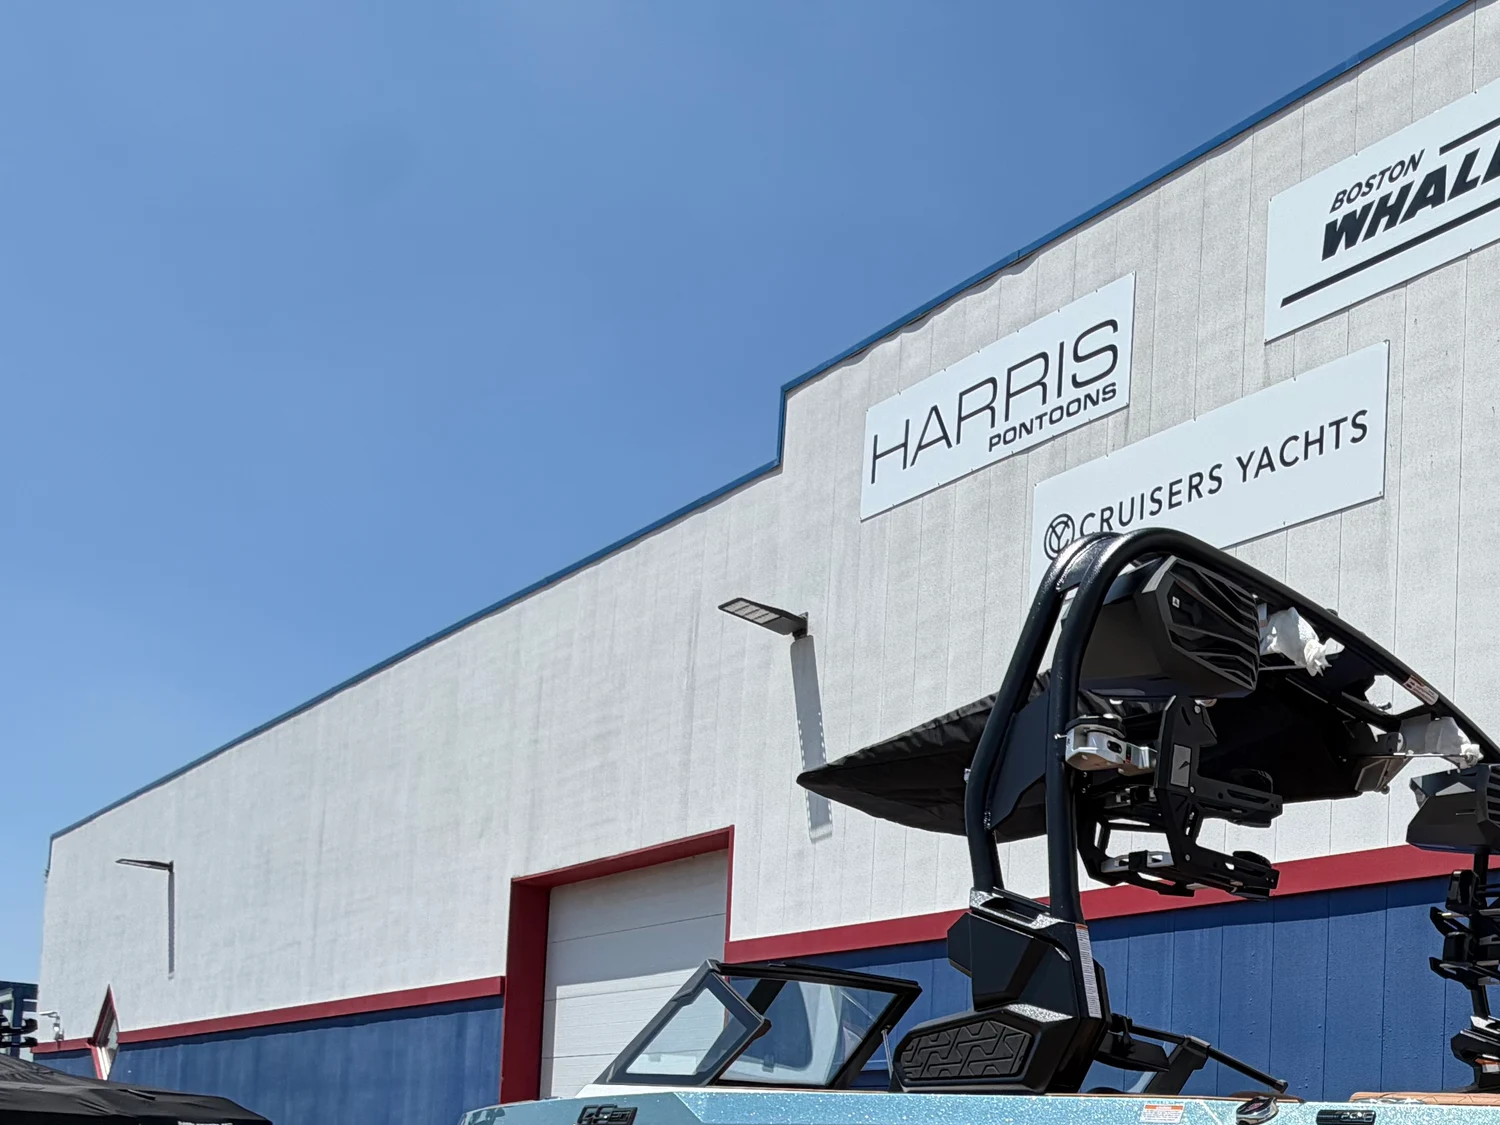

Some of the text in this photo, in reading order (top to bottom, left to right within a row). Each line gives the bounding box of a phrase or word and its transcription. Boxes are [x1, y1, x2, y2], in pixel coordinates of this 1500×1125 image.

[1329, 148, 1425, 214] BOSTON
[870, 319, 1119, 485] HARRIS
[988, 381, 1117, 453] PONTOONS
[1080, 463, 1223, 537] CRUISERS
[1236, 409, 1368, 482] YACHTS
